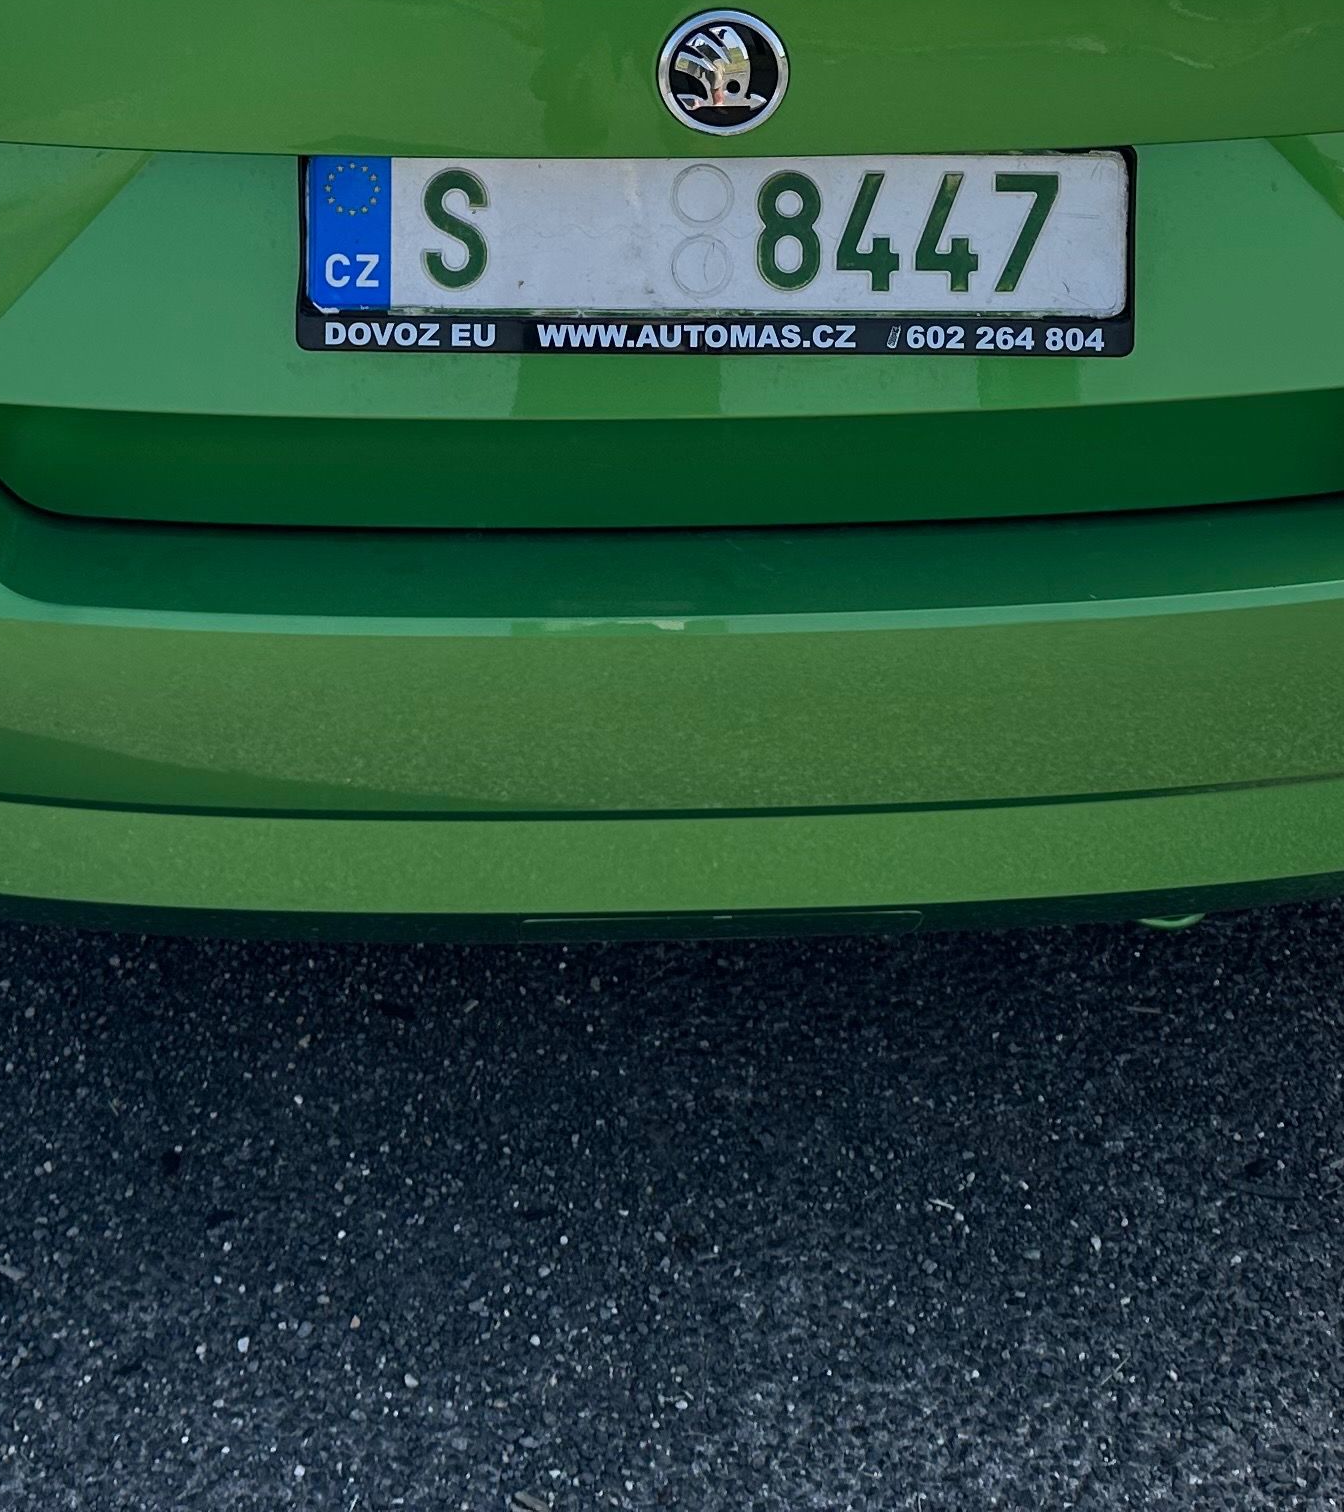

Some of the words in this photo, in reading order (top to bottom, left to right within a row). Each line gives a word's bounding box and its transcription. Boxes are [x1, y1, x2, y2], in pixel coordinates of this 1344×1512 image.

[422, 167, 490, 291] S
[757, 170, 1060, 293] 8447
[325, 253, 380, 288] CZ
[325, 321, 441, 348] DOVOZ
[451, 322, 496, 348] EU
[537, 323, 856, 350] WWW.AUTOMAS.CZ
[905, 326, 965, 350] 602
[975, 327, 1034, 351] 264
[1045, 328, 1105, 352] 804
